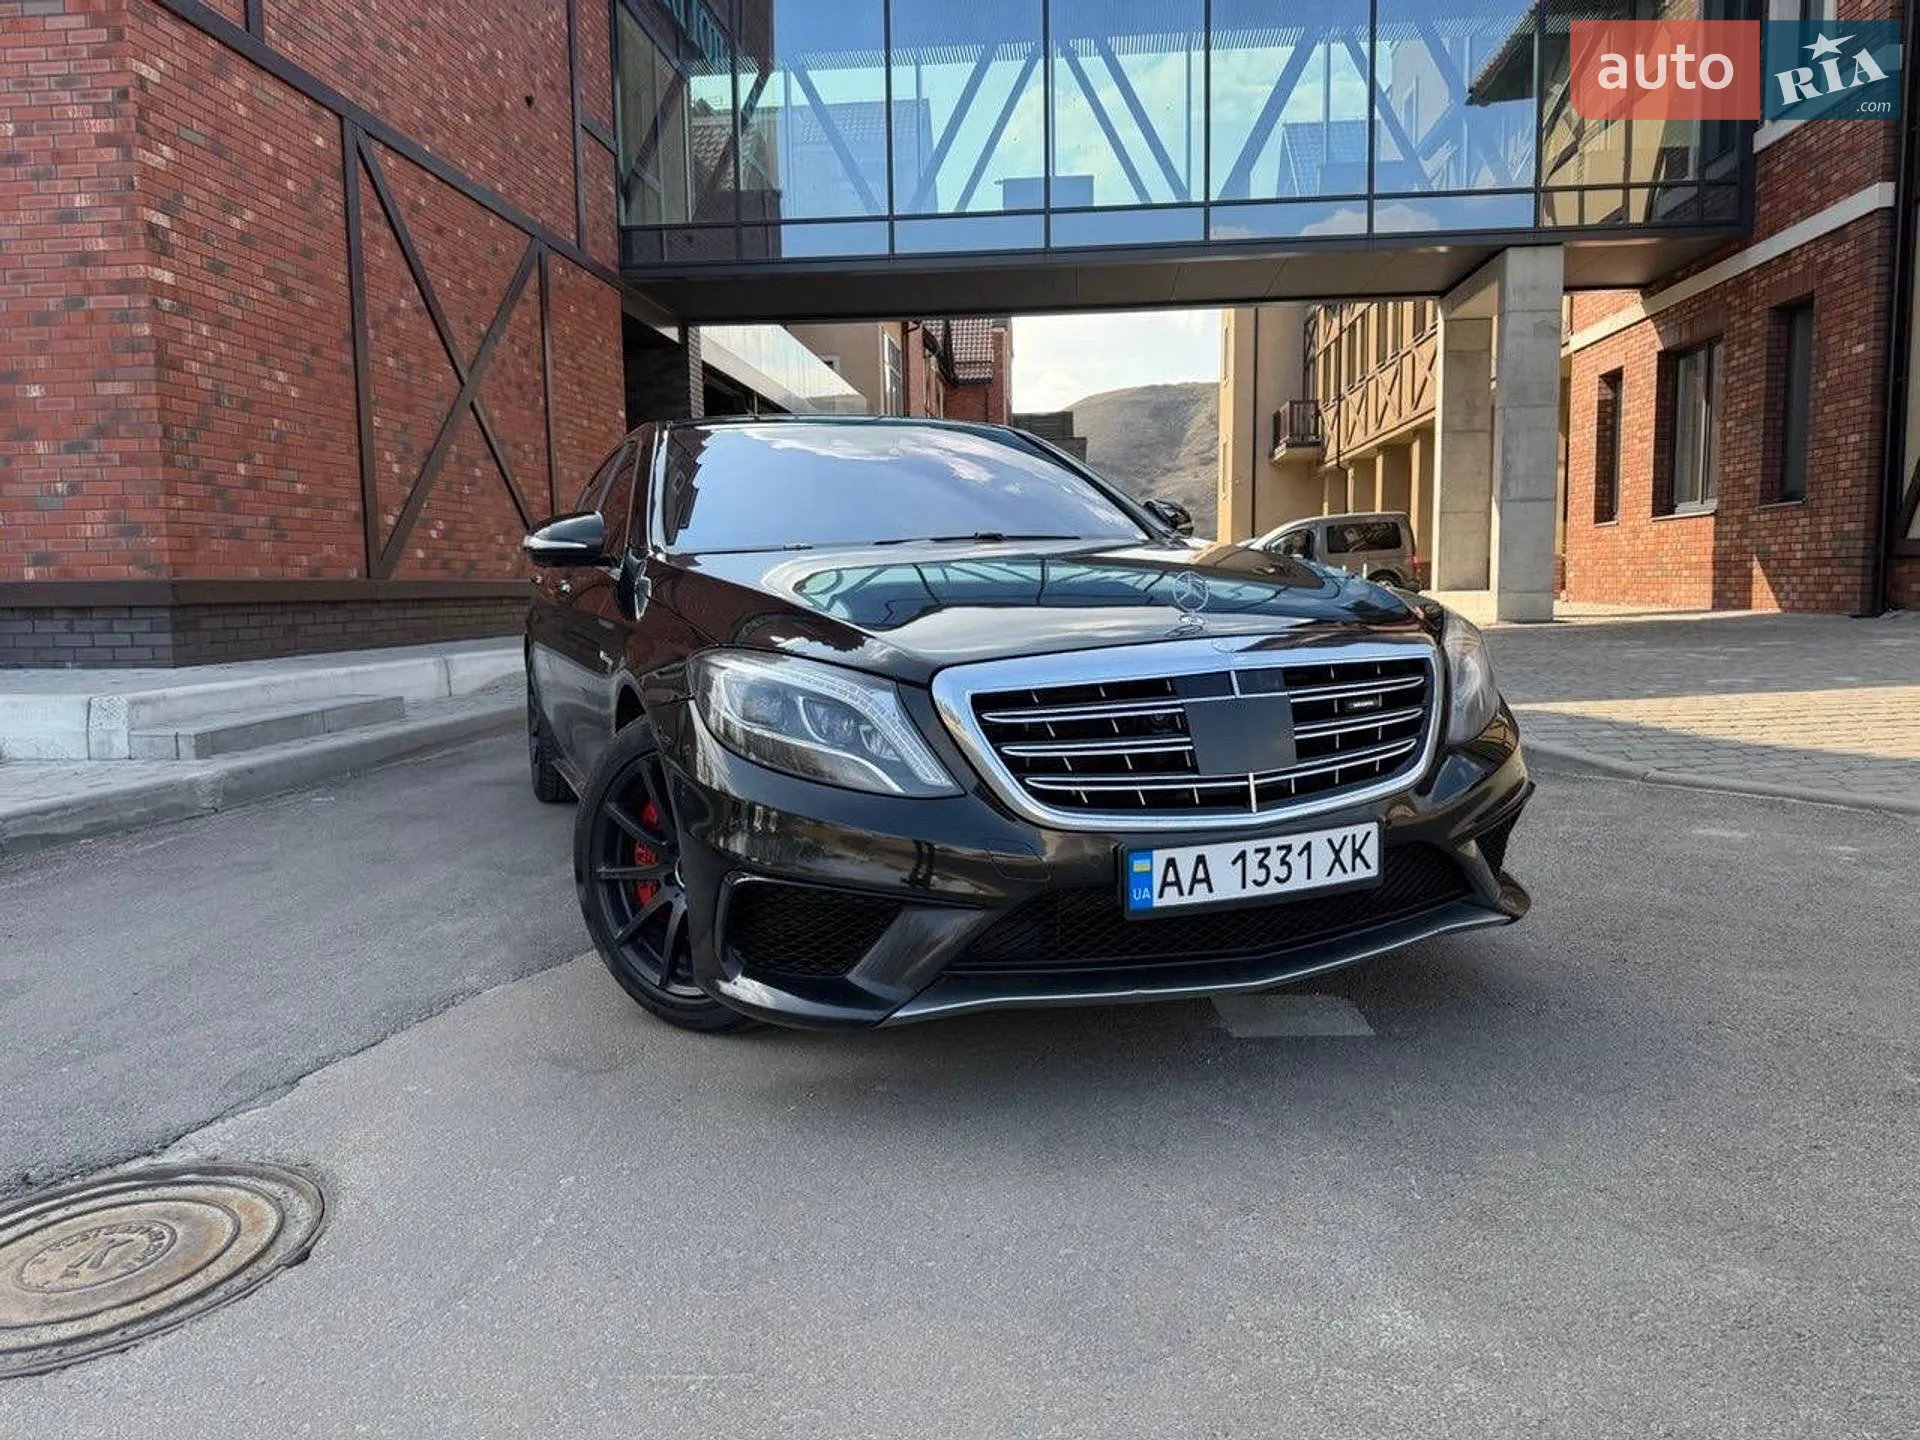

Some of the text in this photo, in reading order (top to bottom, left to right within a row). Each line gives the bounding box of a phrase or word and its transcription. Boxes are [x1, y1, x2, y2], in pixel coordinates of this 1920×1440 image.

[1158, 831, 1372, 899] AA 1331 XK
[1132, 887, 1151, 900] UA
